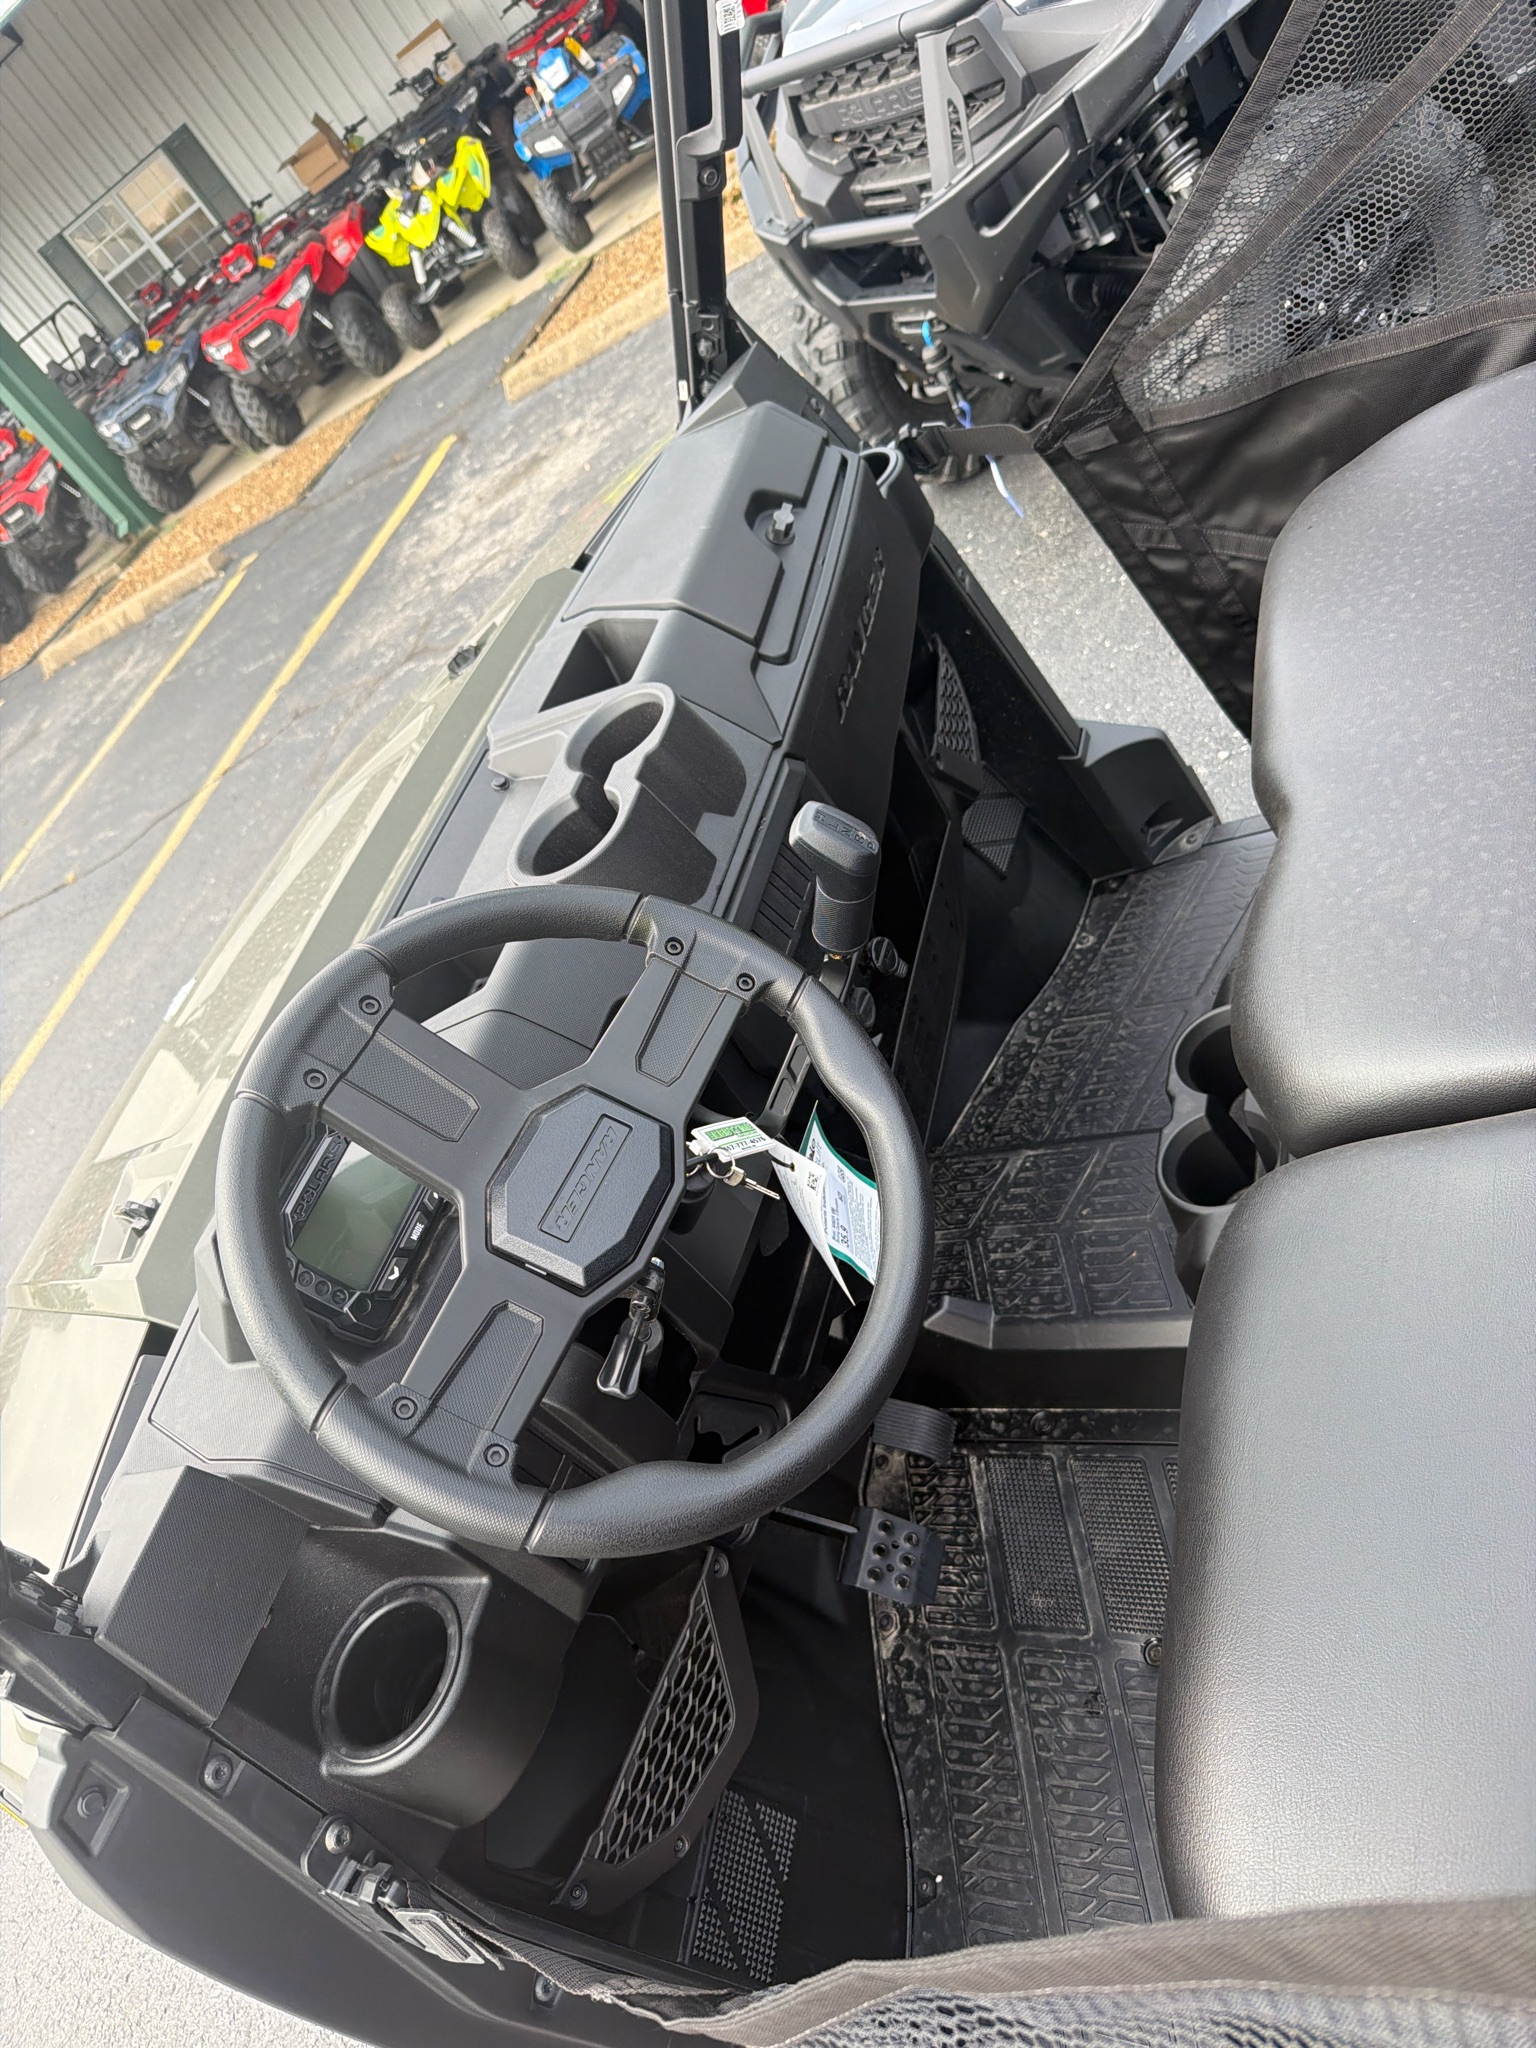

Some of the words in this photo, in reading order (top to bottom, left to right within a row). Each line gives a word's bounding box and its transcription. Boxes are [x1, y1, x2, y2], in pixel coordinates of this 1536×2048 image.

[294, 1140, 343, 1218] POLARIS
[555, 1126, 618, 1230] RANGER
[410, 1222, 425, 1241] MODE
